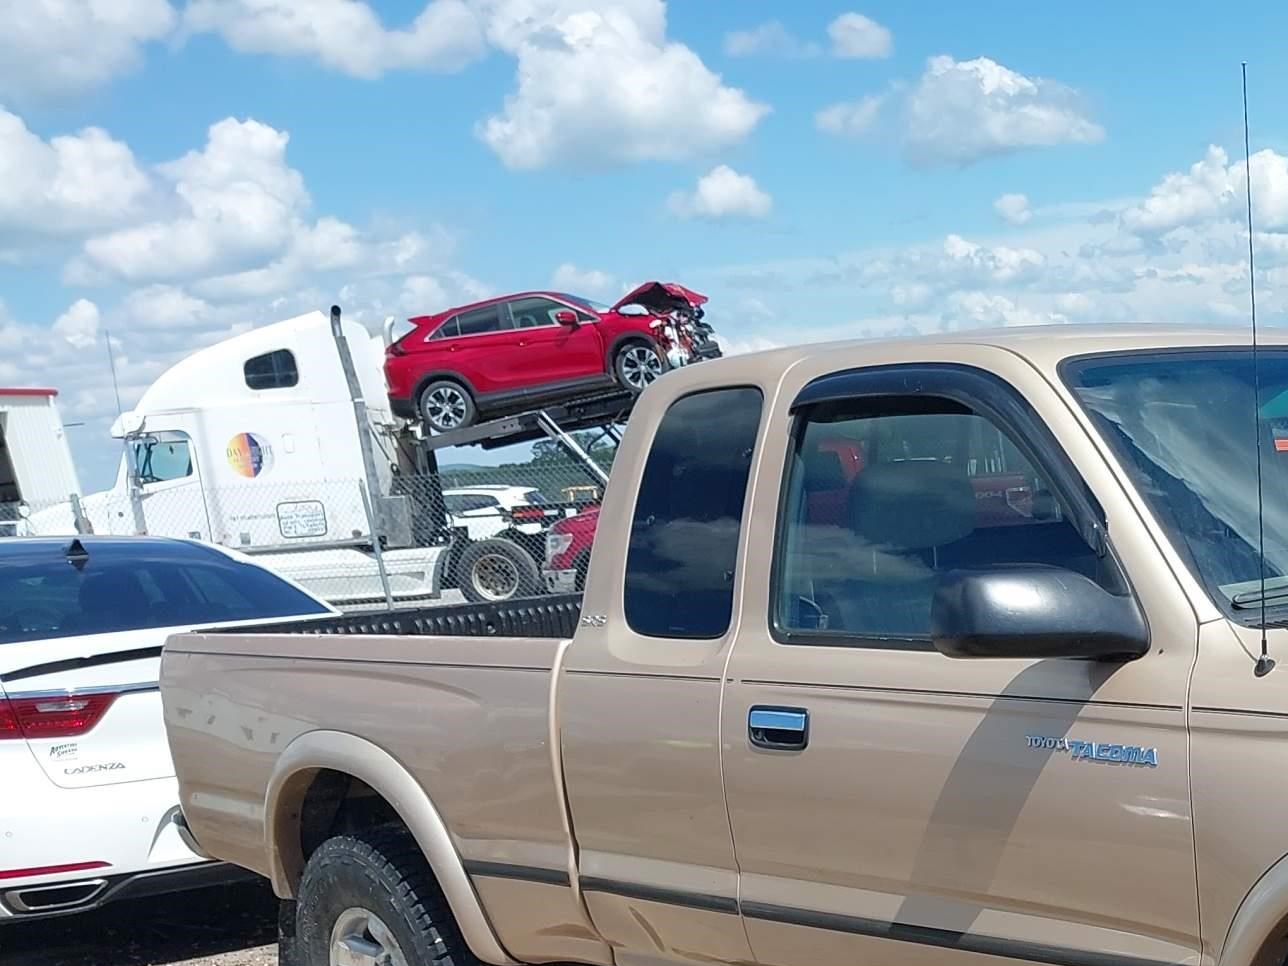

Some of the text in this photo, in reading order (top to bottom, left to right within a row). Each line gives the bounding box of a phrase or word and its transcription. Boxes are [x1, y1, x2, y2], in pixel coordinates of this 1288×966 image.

[1025, 735, 1158, 766] TOYOTA TACOMA
[63, 762, 126, 775] CADENZA
